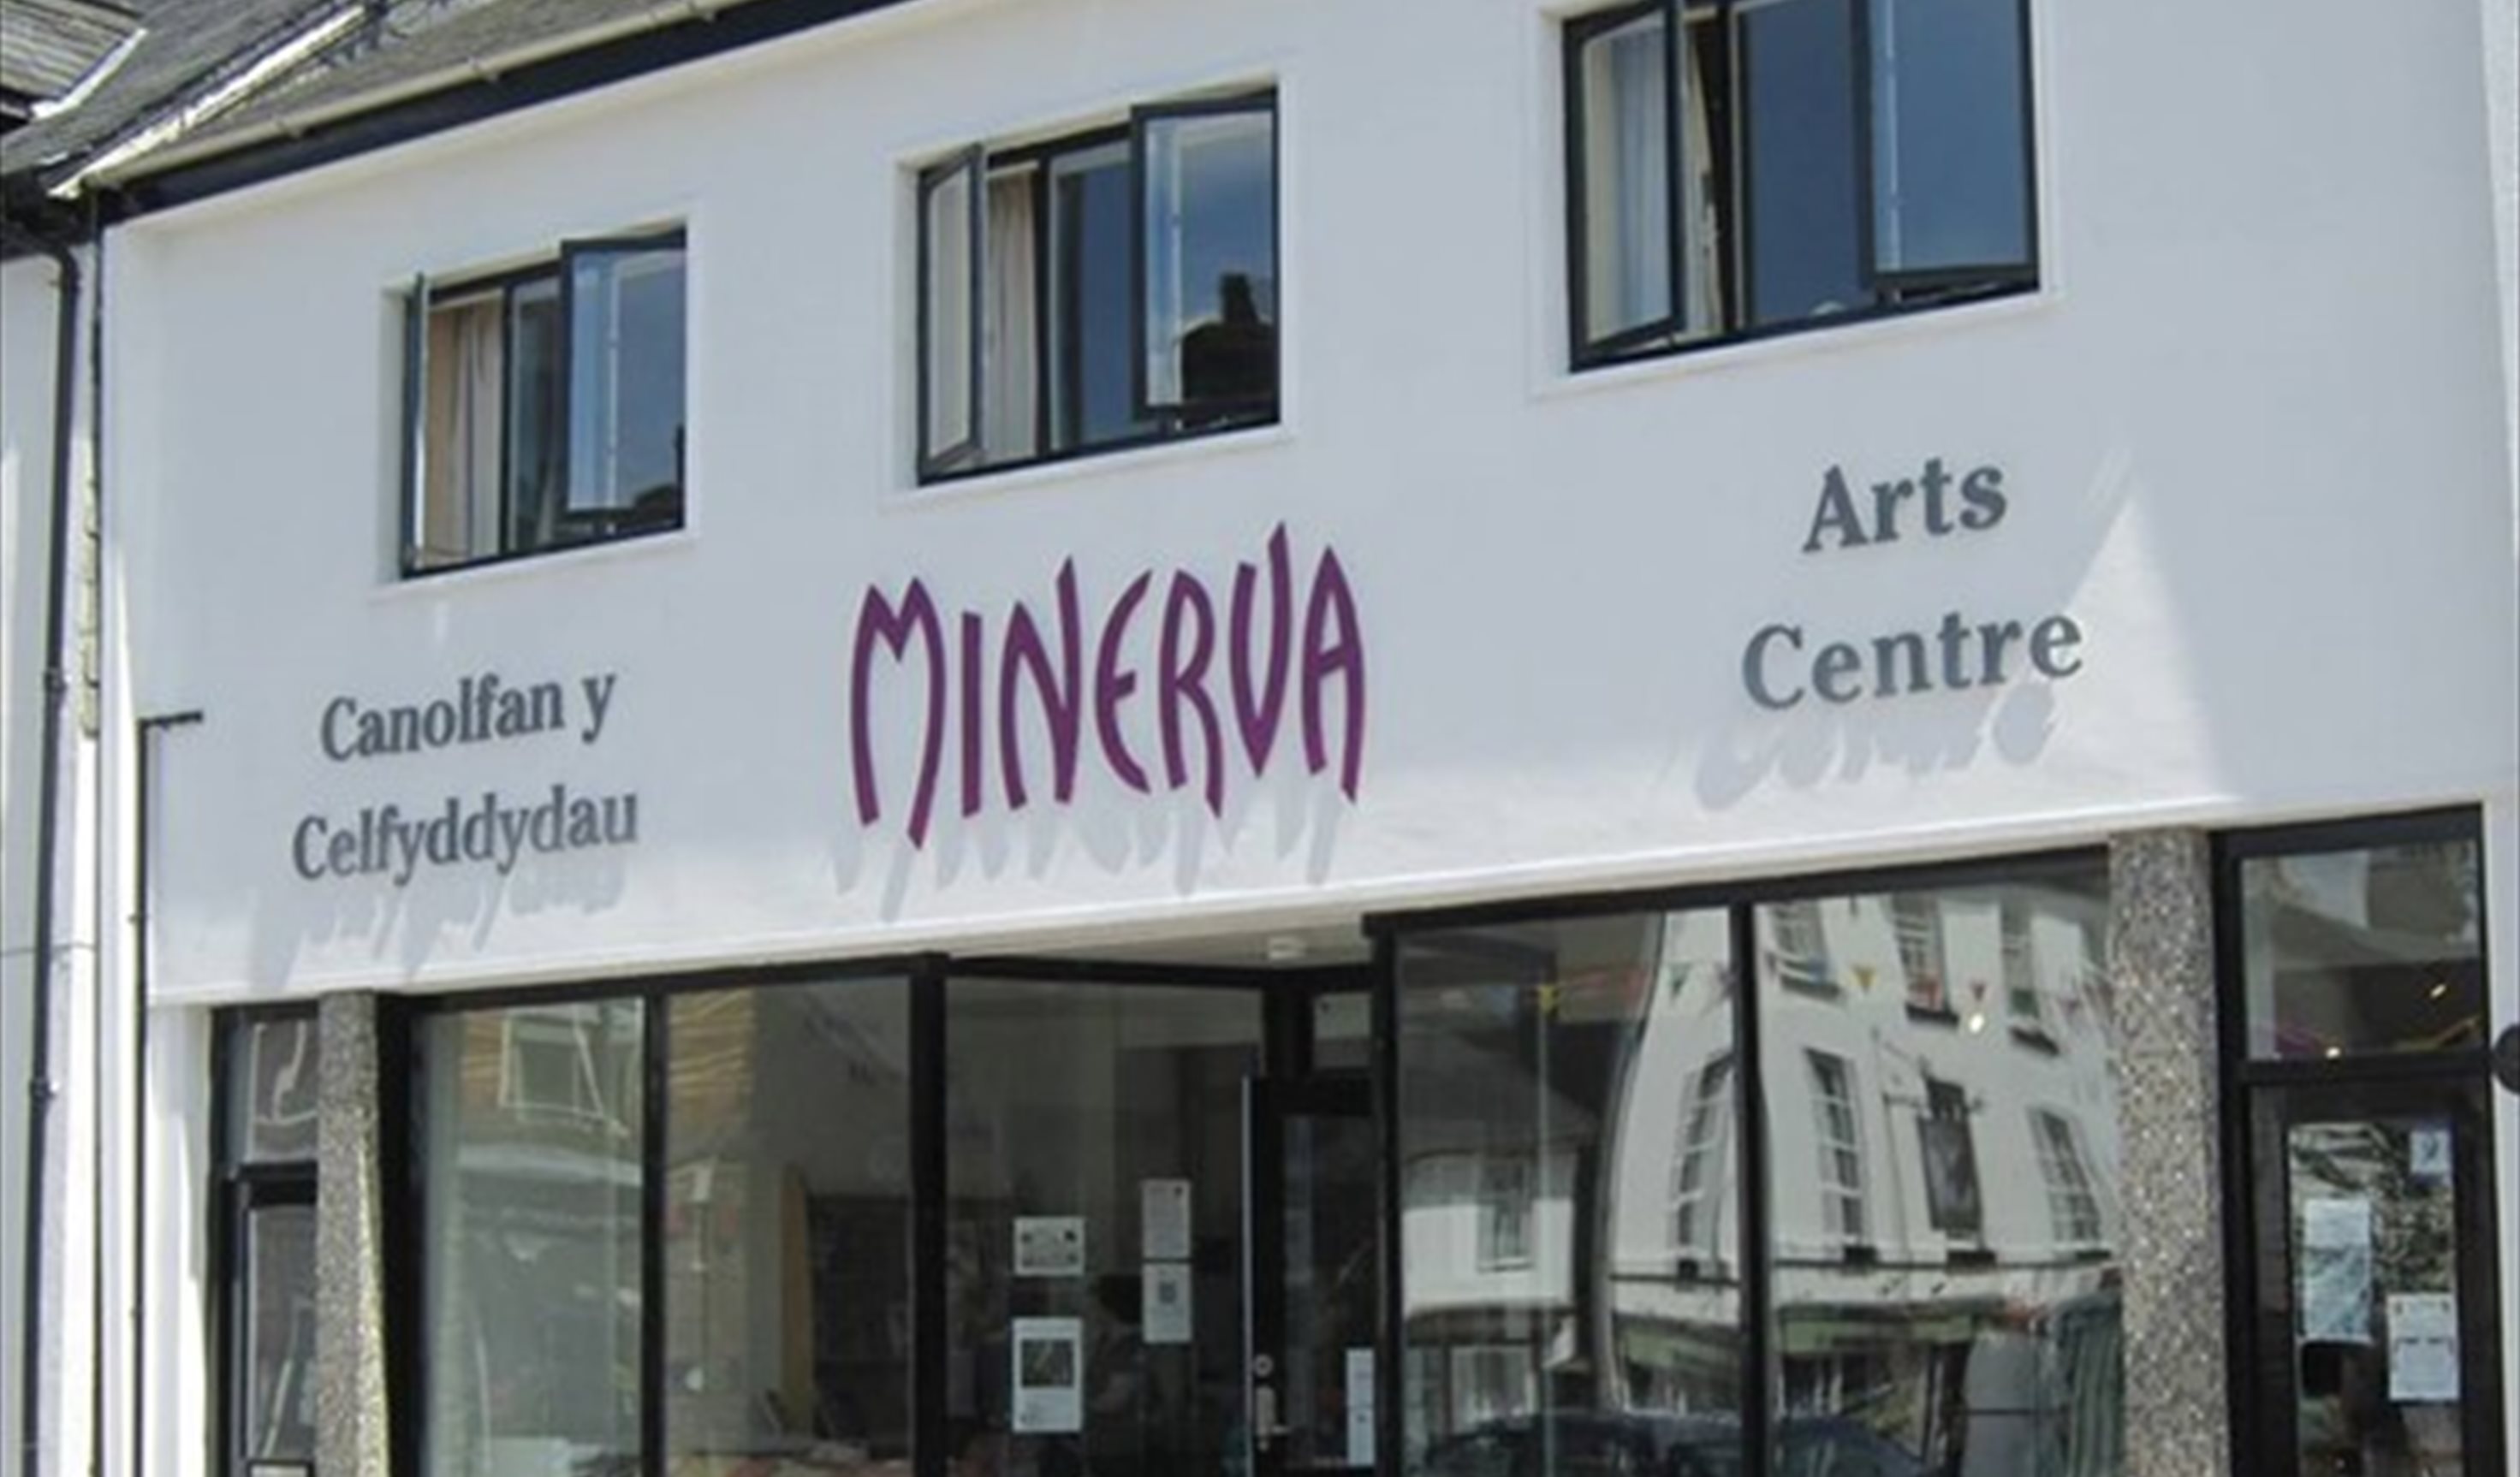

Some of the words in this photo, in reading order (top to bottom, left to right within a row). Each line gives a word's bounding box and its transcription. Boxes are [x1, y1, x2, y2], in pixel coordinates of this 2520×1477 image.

[1802, 457, 2007, 553] Arts
[850, 520, 1364, 851] MINERVA
[1741, 610, 2083, 710] Centre
[320, 673, 565, 762] Canolfan
[581, 673, 617, 743] y
[292, 784, 639, 886] Celfyddydau
